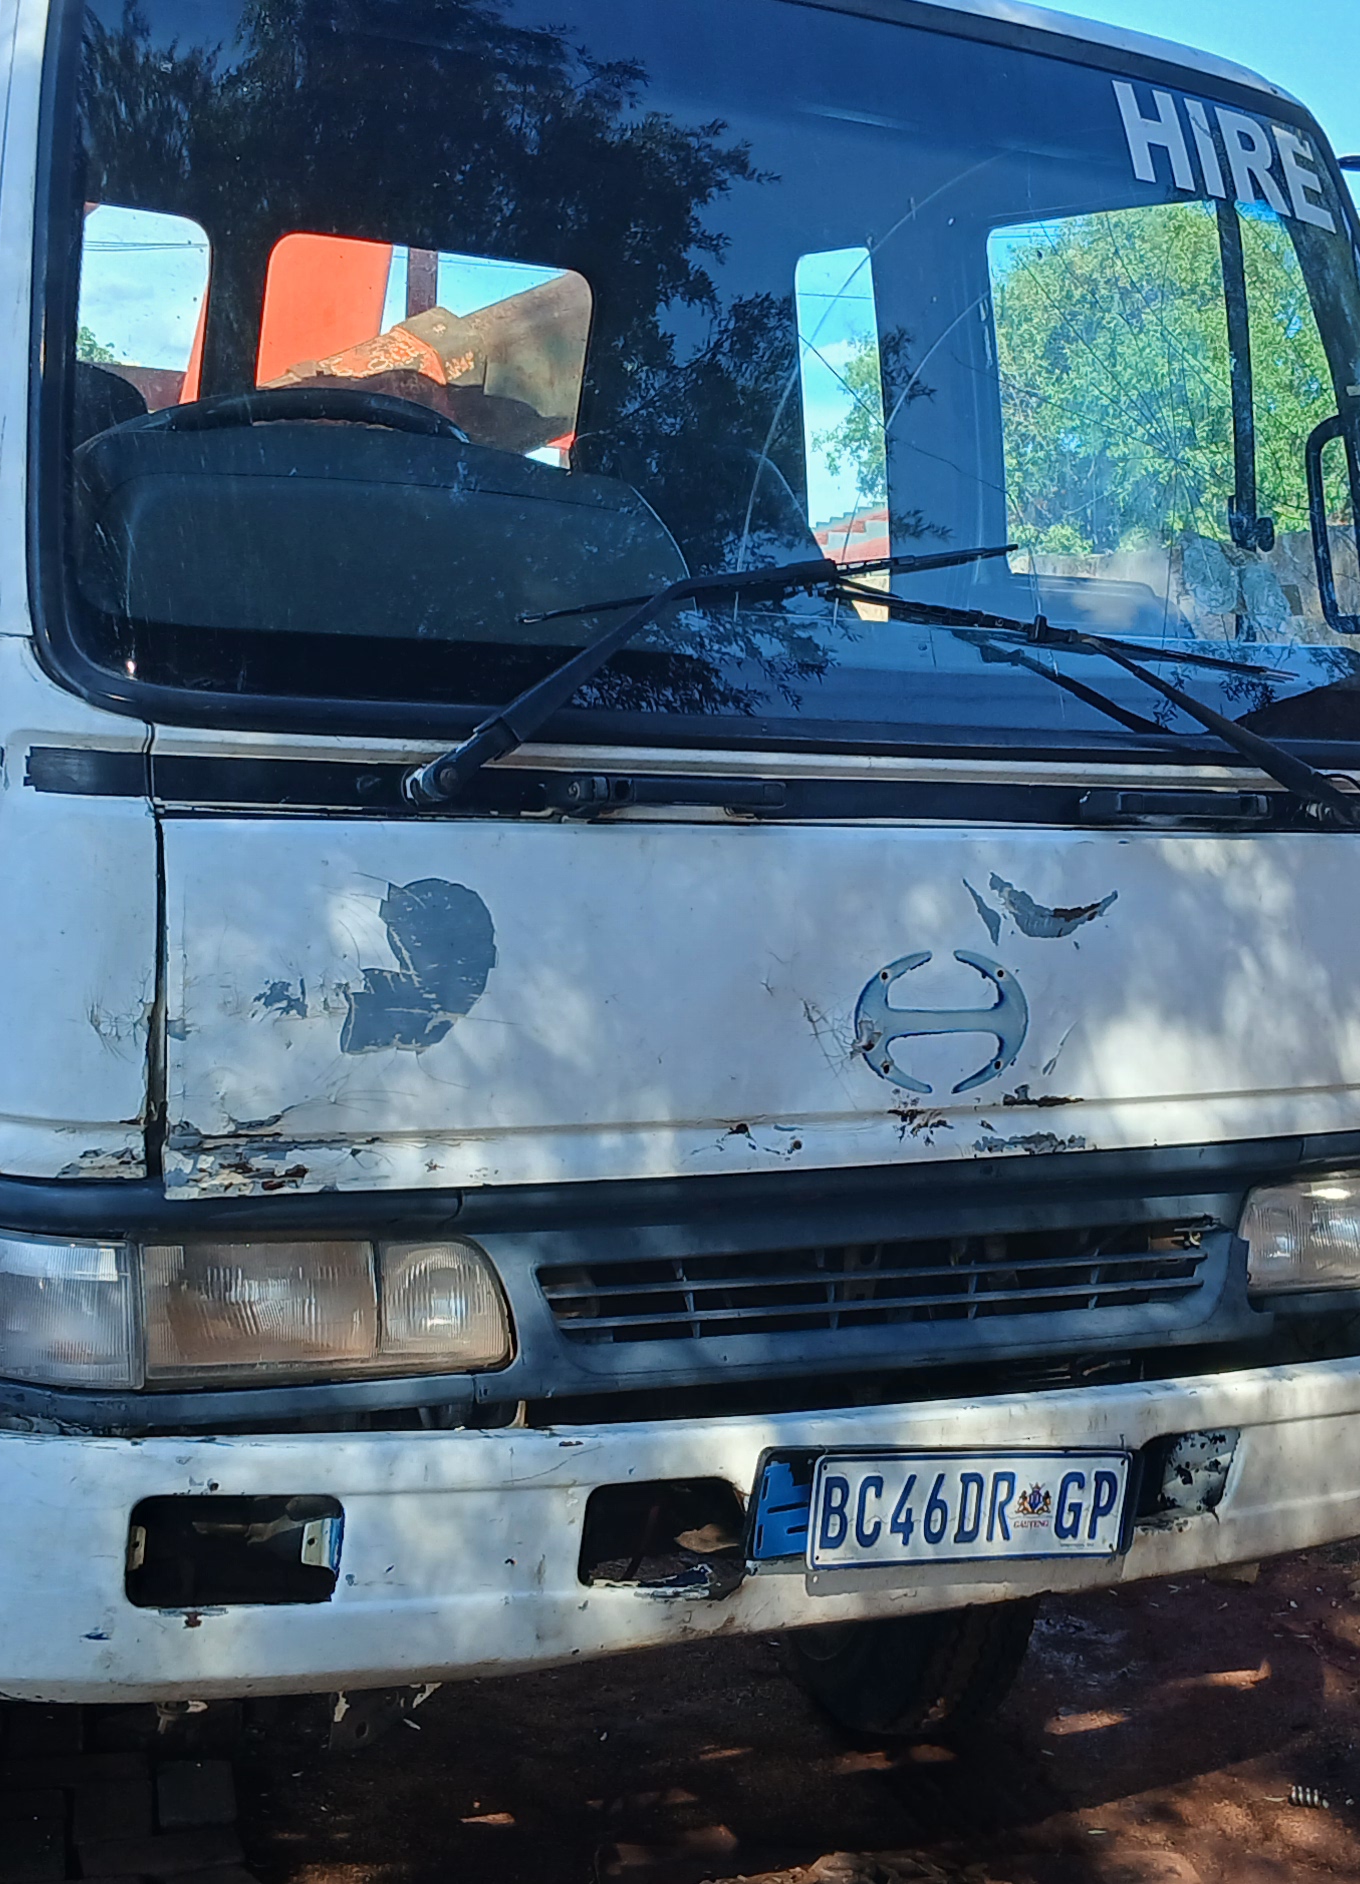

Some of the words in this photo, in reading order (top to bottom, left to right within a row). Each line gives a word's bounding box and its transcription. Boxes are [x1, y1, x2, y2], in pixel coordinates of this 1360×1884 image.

[1111, 79, 1337, 234] HIRE
[820, 1471, 1016, 1549] BC46DR
[1054, 1471, 1118, 1540] GP
